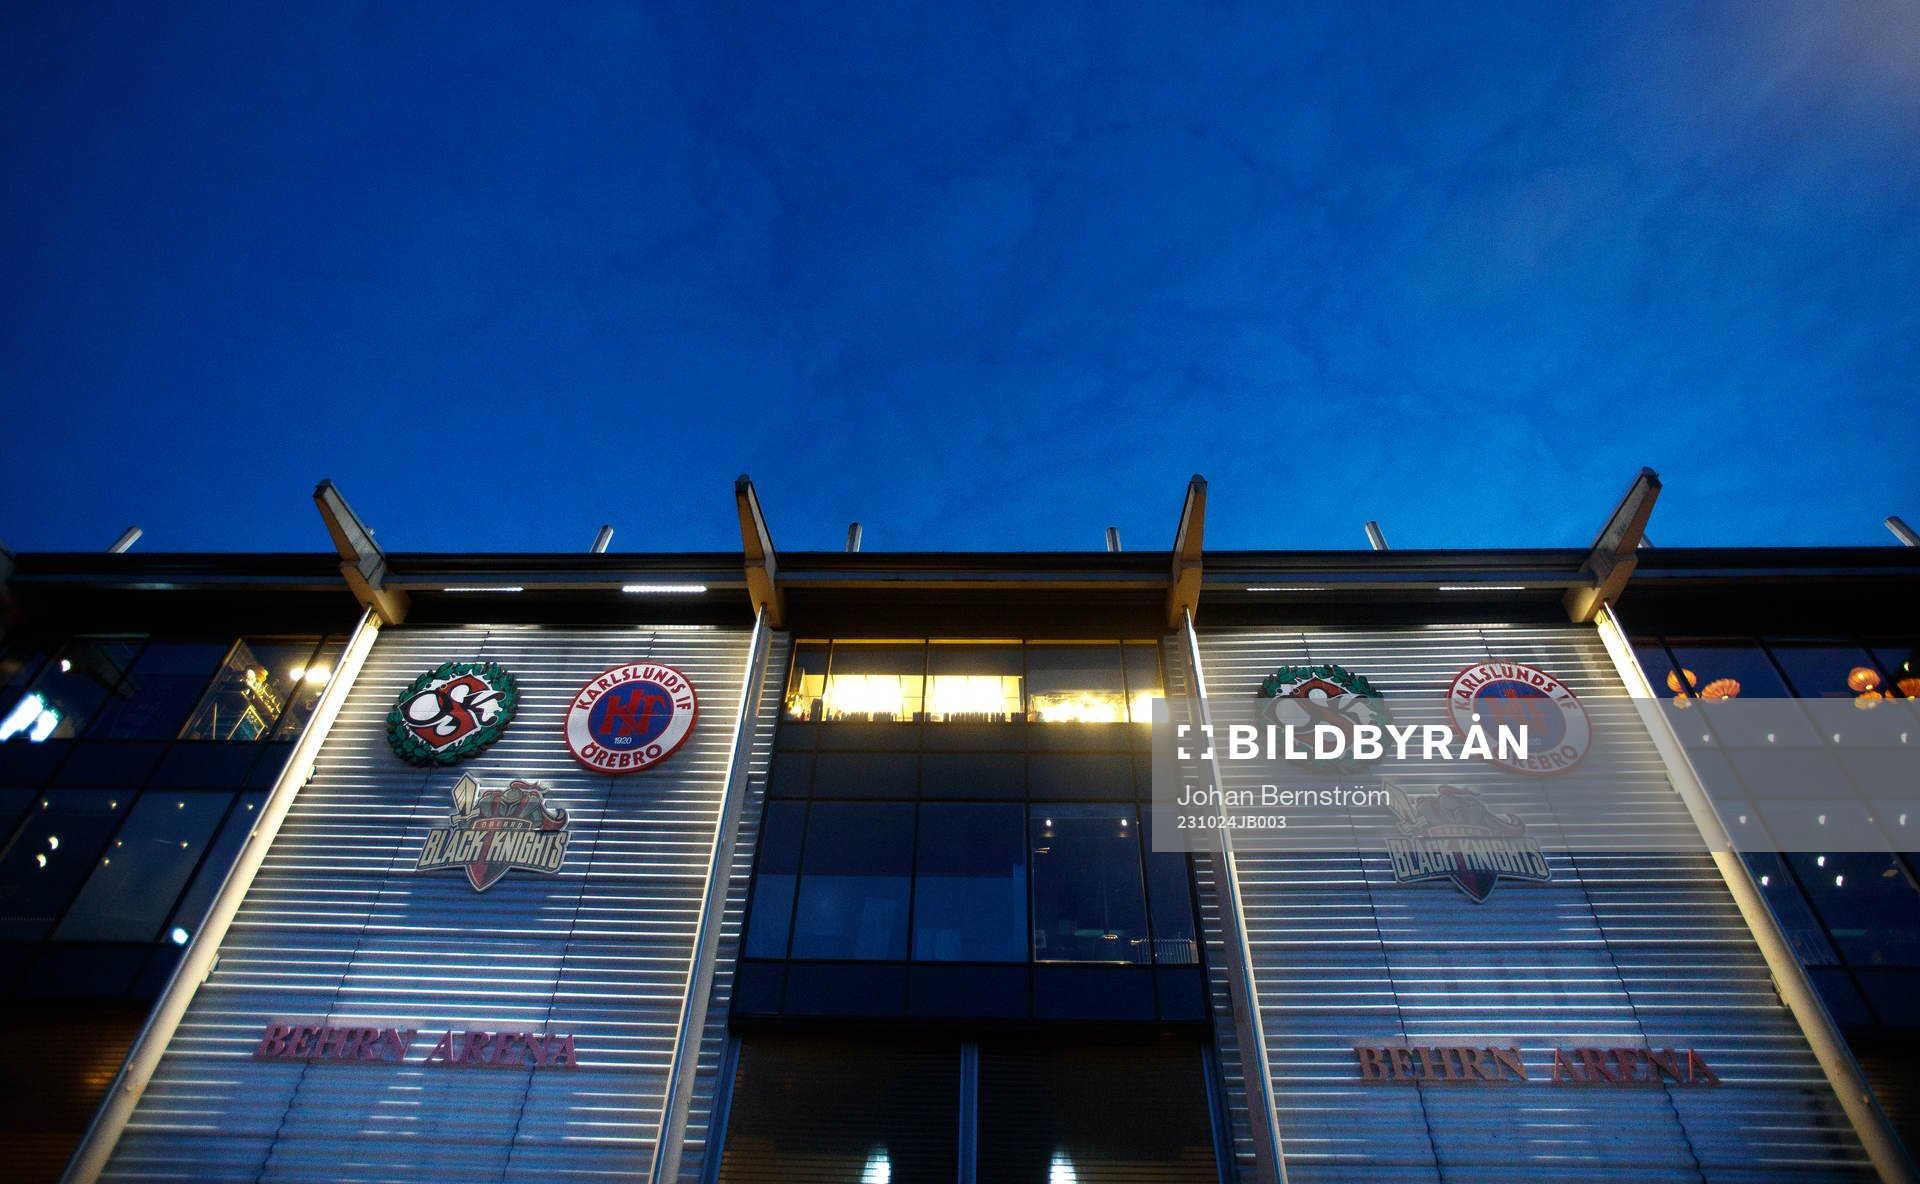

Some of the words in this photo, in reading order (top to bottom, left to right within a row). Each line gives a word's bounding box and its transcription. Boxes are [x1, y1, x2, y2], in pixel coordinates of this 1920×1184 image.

[575, 665, 685, 710] KARLSLUNDS
[676, 687, 692, 712] IF
[1454, 663, 1557, 712] KARLSLUNDS
[1556, 689, 1579, 712] IF
[580, 742, 663, 769] ÖREBRO
[613, 736, 633, 746] 1920
[1494, 744, 1580, 772] REBRO
[419, 830, 488, 868] BLACK
[486, 830, 568, 870] KNIGHTS
[1391, 837, 1456, 876] BLACK
[1460, 837, 1550, 878] KNIGHTS
[253, 1024, 418, 1062] BEHRN
[424, 1029, 578, 1068] ARENA
[1354, 1046, 1529, 1083] BEHRN
[1551, 1047, 1722, 1087] ARENA
